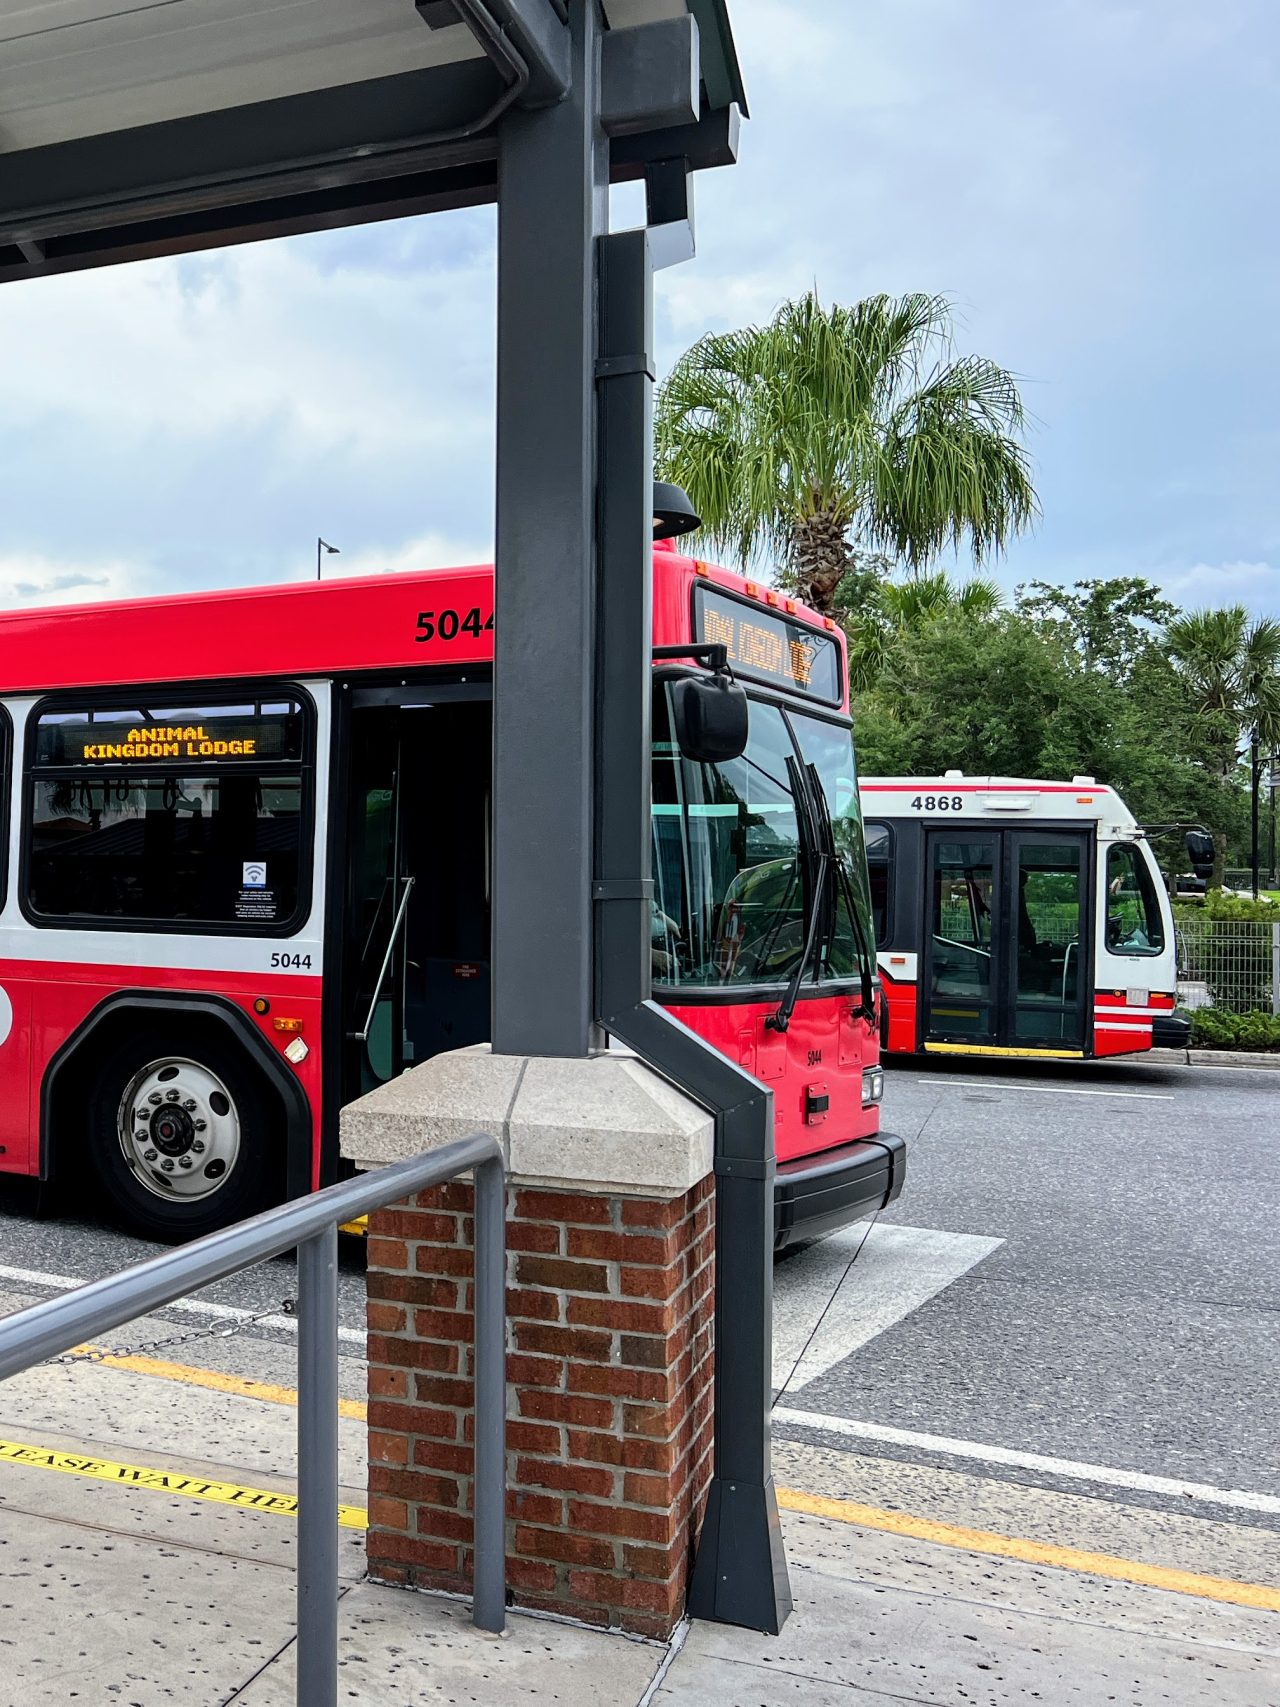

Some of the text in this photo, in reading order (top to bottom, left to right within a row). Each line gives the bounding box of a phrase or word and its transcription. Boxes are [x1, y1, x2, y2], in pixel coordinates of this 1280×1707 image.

[127, 726, 209, 742] ANIMAL
[83, 740, 256, 758] KINGDOM LODGE
[911, 796, 963, 811] 4868
[270, 952, 312, 970] 5044
[118, 1468, 223, 1494] WAIT
